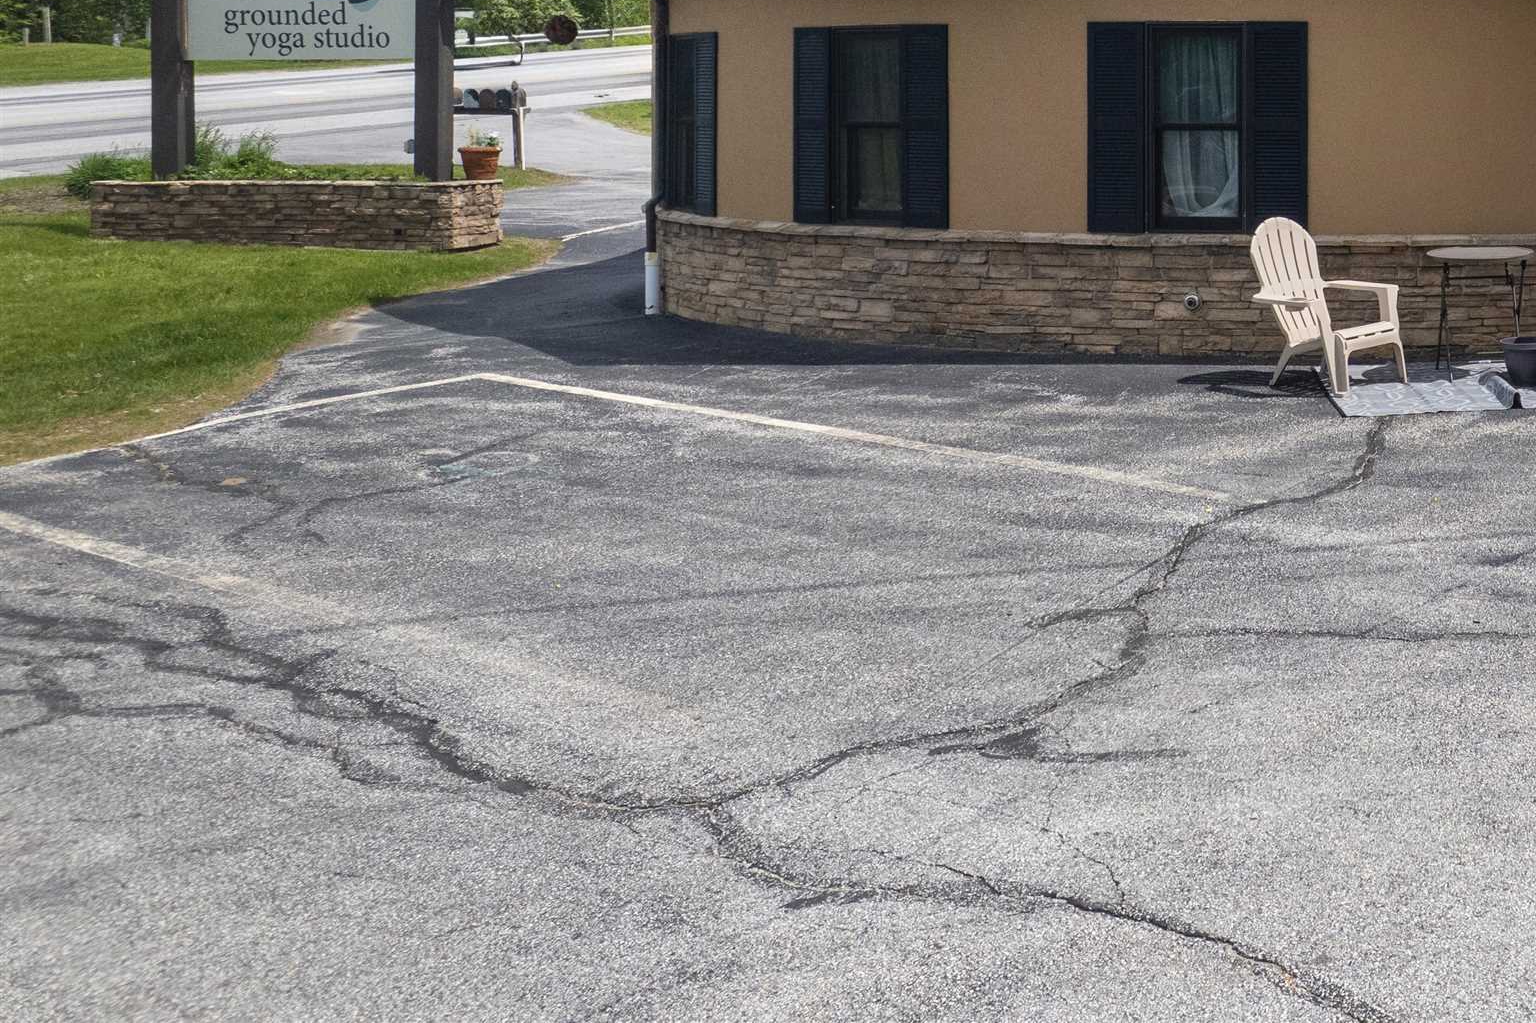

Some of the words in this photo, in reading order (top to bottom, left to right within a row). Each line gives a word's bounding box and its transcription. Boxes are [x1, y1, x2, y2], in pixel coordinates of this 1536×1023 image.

[224, 1, 348, 34] grounded
[247, 32, 305, 57] yoga
[313, 24, 391, 49] studio
